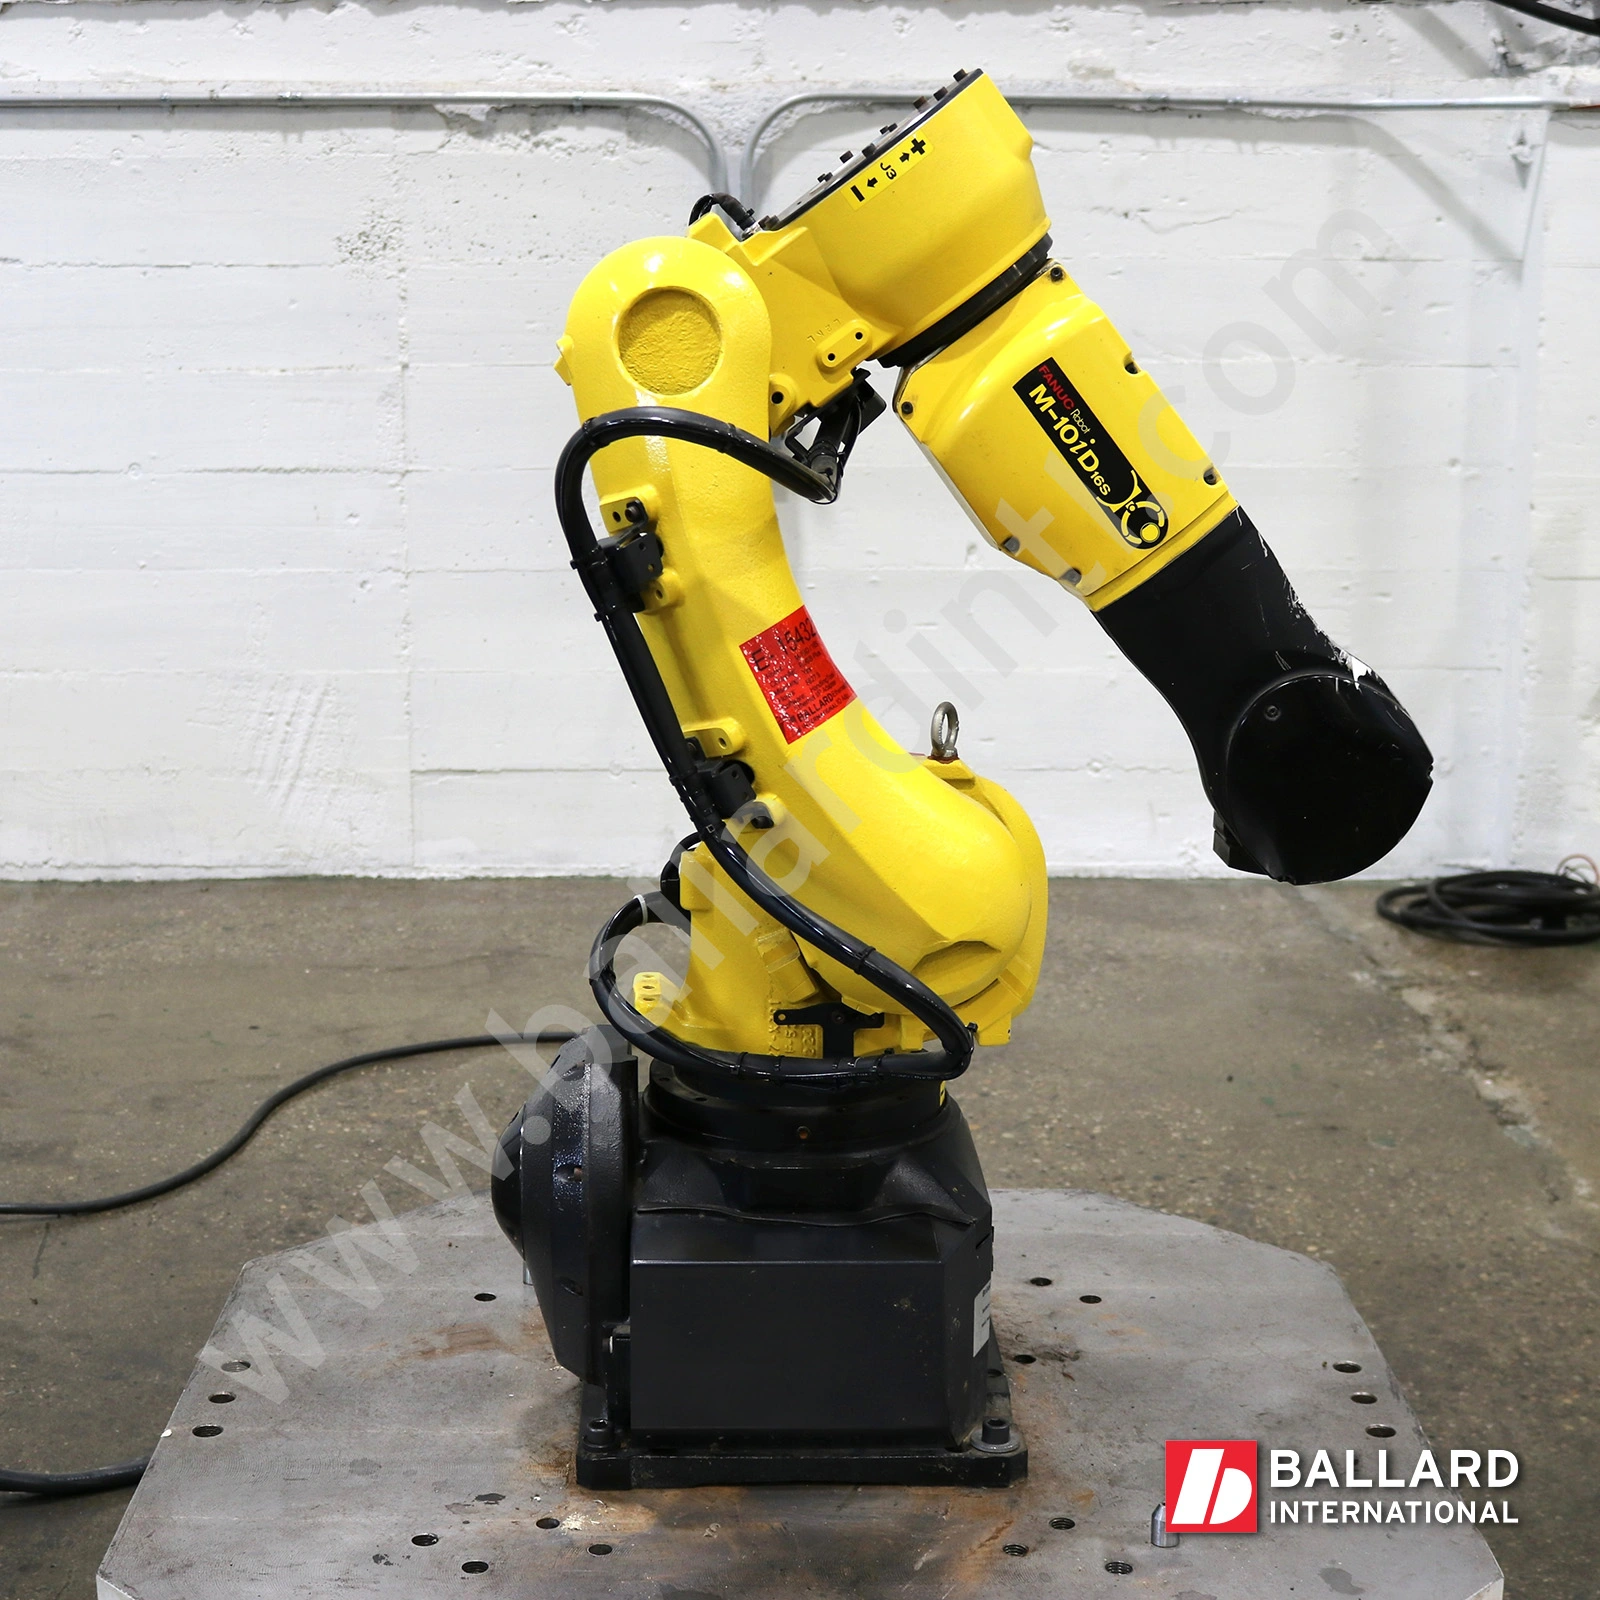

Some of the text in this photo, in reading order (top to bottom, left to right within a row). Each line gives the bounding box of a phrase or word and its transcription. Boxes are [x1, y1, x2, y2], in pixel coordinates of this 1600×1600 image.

[880, 162, 897, 180] J3
[1038, 364, 1090, 434] FANUC Robot
[796, 693, 835, 722] BALLARD
